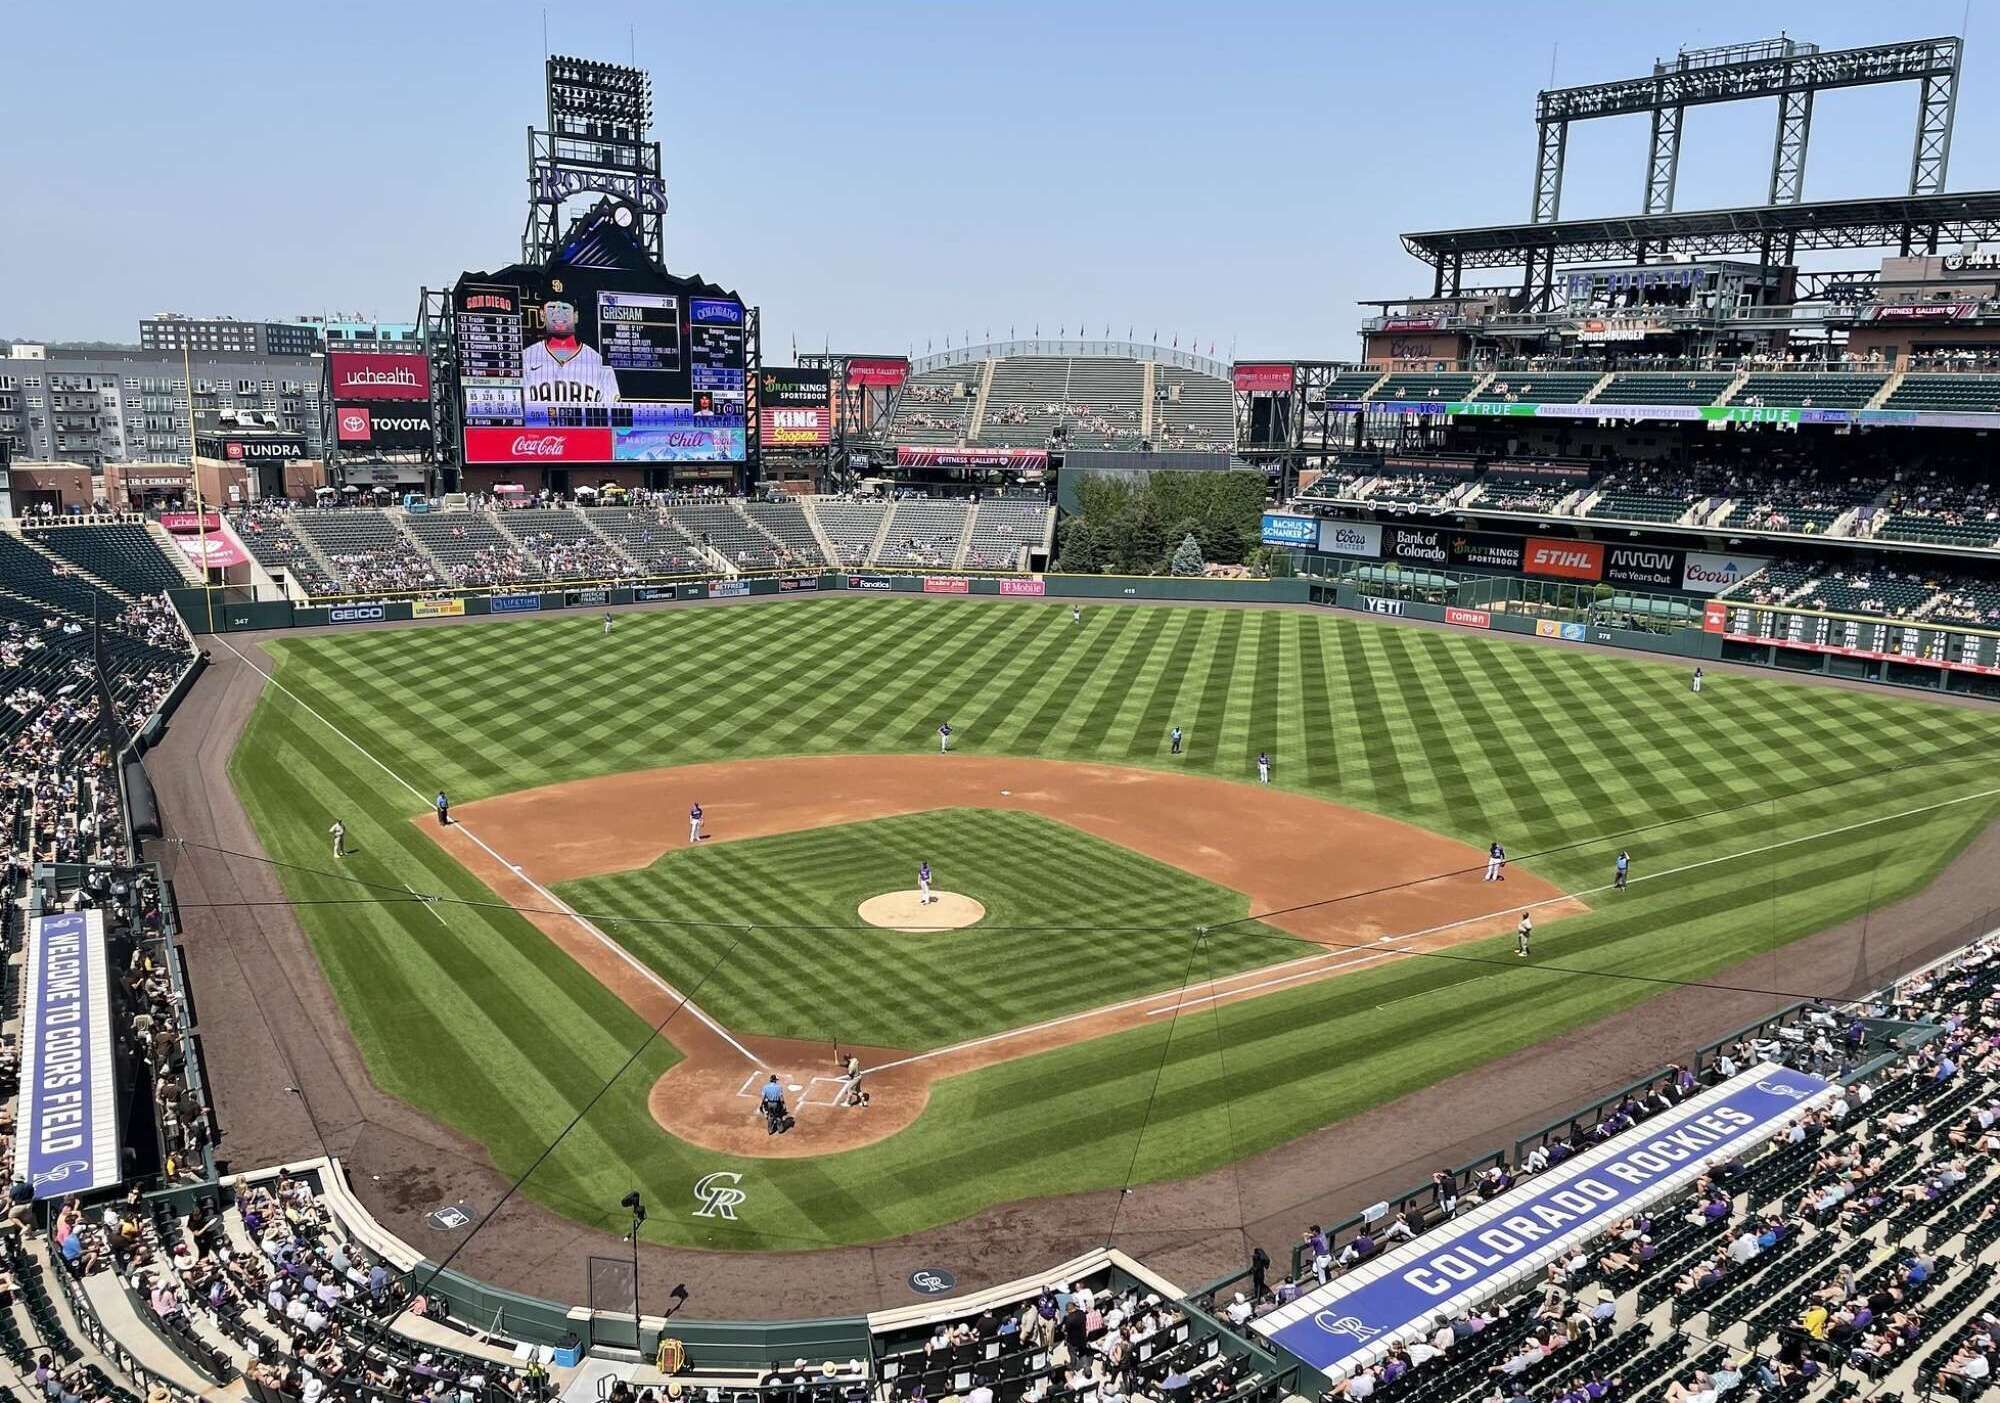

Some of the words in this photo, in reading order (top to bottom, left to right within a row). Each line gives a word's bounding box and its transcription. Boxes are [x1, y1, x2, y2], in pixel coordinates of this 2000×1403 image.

[536, 165, 668, 214] ROCKIES
[603, 306, 643, 321] GRISHAM
[1916, 307, 1946, 315] GALLERY
[347, 366, 416, 384] uchealth
[765, 383, 828, 393] DRAFTKINGS
[1471, 404, 1511, 415] TRUE
[1740, 410, 1791, 422] TRUE
[371, 419, 430, 431] TOYOTA
[773, 411, 818, 427] KING
[512, 436, 566, 456] Coca-Cola
[669, 432, 704, 448] Chill
[243, 445, 301, 456] TUNDRA
[970, 457, 999, 465] GALLERY
[1336, 530, 1366, 544] Coors
[1397, 531, 1424, 544] Bank
[1425, 533, 1438, 545] of
[1397, 544, 1446, 560] Colorado
[1455, 544, 1519, 558] DRAFTKINGS
[1468, 555, 1518, 566] SPORTSBOOK
[1534, 550, 1592, 569] STIHL
[1609, 569, 1628, 579] Five
[1628, 571, 1653, 583] Years
[1653, 574, 1672, 584] Out
[1686, 564, 1730, 584] Coors
[860, 580, 889, 588] Fanatics
[1012, 582, 1040, 592] Mobile
[332, 608, 382, 620] GEICO
[1367, 598, 1401, 615] YETI
[1452, 612, 1484, 623] roman
[1963, 650, 1977, 658] LAA
[46, 931, 81, 1002] WELCOME
[45, 1002, 81, 1025] TO
[43, 1026, 82, 1090] COORS
[41, 1091, 82, 1155] FIELD
[692, 1172, 746, 1220] CR
[1403, 1177, 1619, 1296] COLORADO
[1604, 1104, 1755, 1186] ROCKIES
